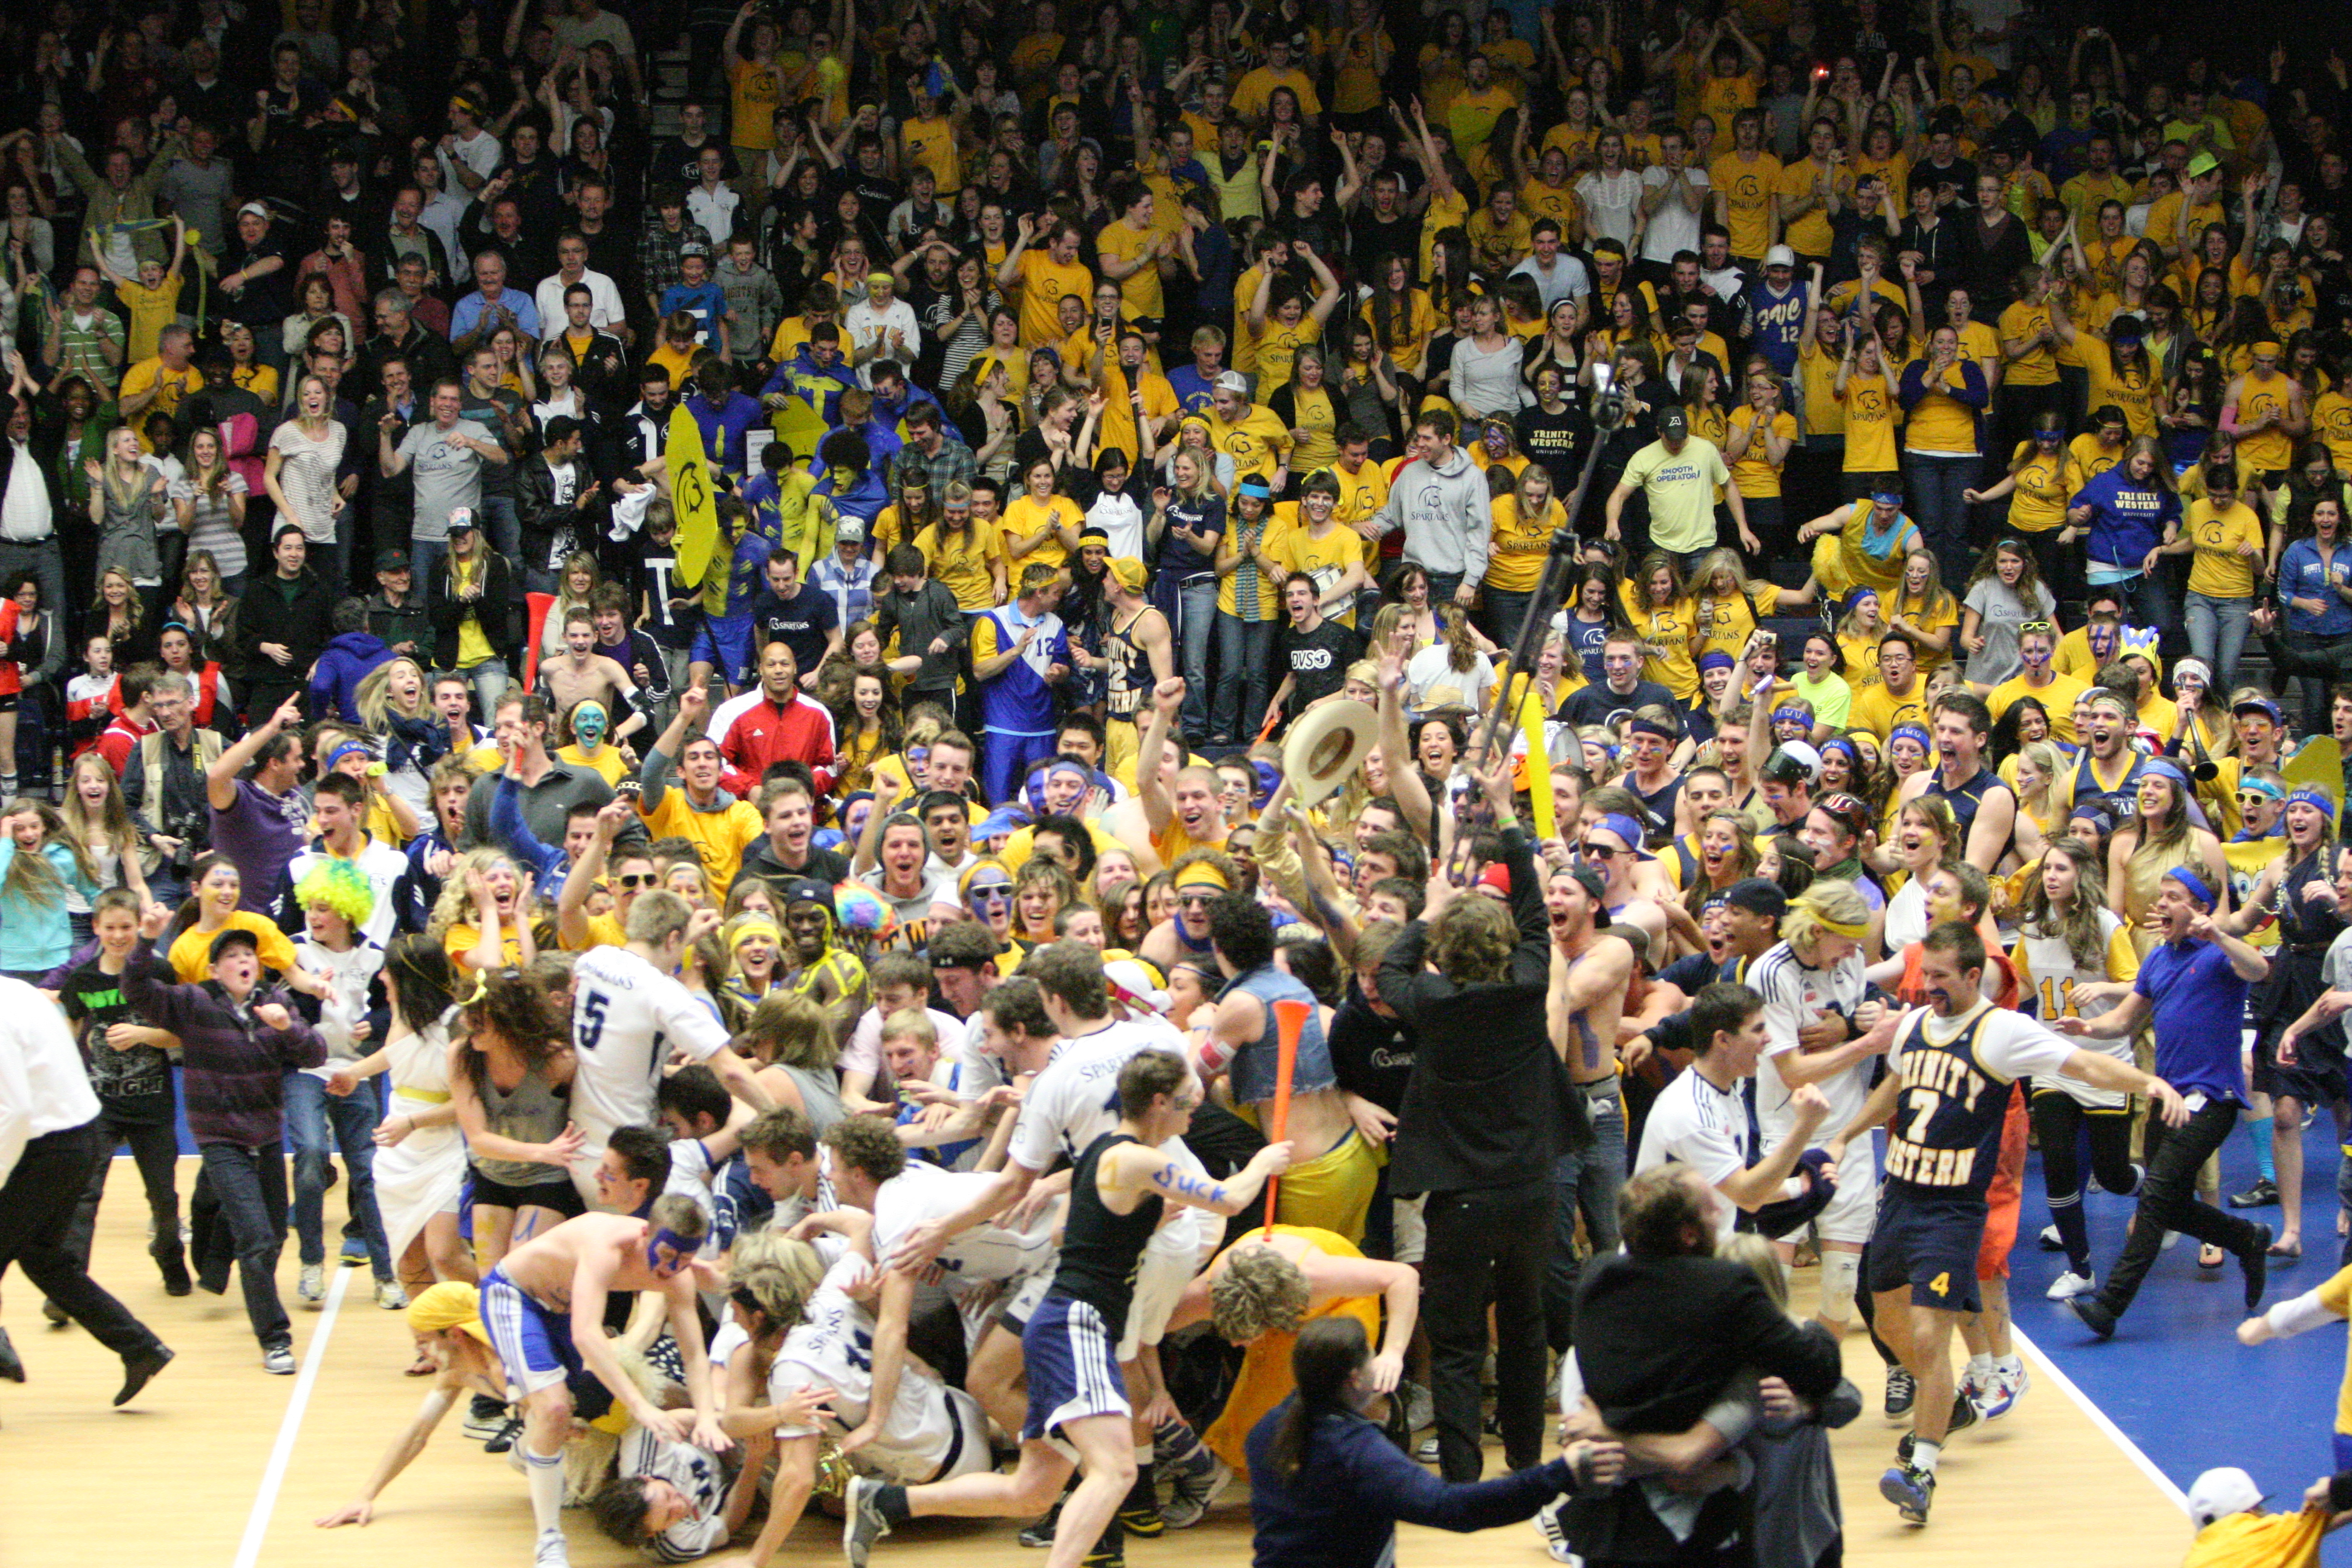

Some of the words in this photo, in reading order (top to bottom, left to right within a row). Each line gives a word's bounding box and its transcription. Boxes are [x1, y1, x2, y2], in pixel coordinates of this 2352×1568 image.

[1781, 325, 1799, 343] 12
[1270, 353, 1294, 364] SPART
[2106, 390, 2147, 403] SPARTANS
[1852, 411, 1887, 423] SPARTANS
[1533, 430, 1575, 440] TRINITY
[1529, 437, 1575, 449] WESTERN
[1661, 465, 1694, 475] SMOOTH
[2117, 491, 2158, 501] TRINITY
[2114, 500, 2161, 510] WESTERN
[1410, 510, 1449, 522] SPARTANS
[779, 622, 810, 631] SPARTANS
[1036, 637, 1055, 658] 12
[1578, 647, 1604, 655] SPARTA
[1291, 650, 1315, 670] DVS
[1778, 708, 1802, 720] TWU
[1898, 728, 1921, 738] TWU
[1820, 740, 1840, 752] TWU
[2287, 794, 2311, 803] TWU
[2039, 976, 2081, 1021] 11
[580, 989, 611, 1051] 5
[1901, 1049, 1987, 1113] RINITY
[1908, 1088, 1941, 1144] 7
[1929, 1271, 1950, 1298] 4
